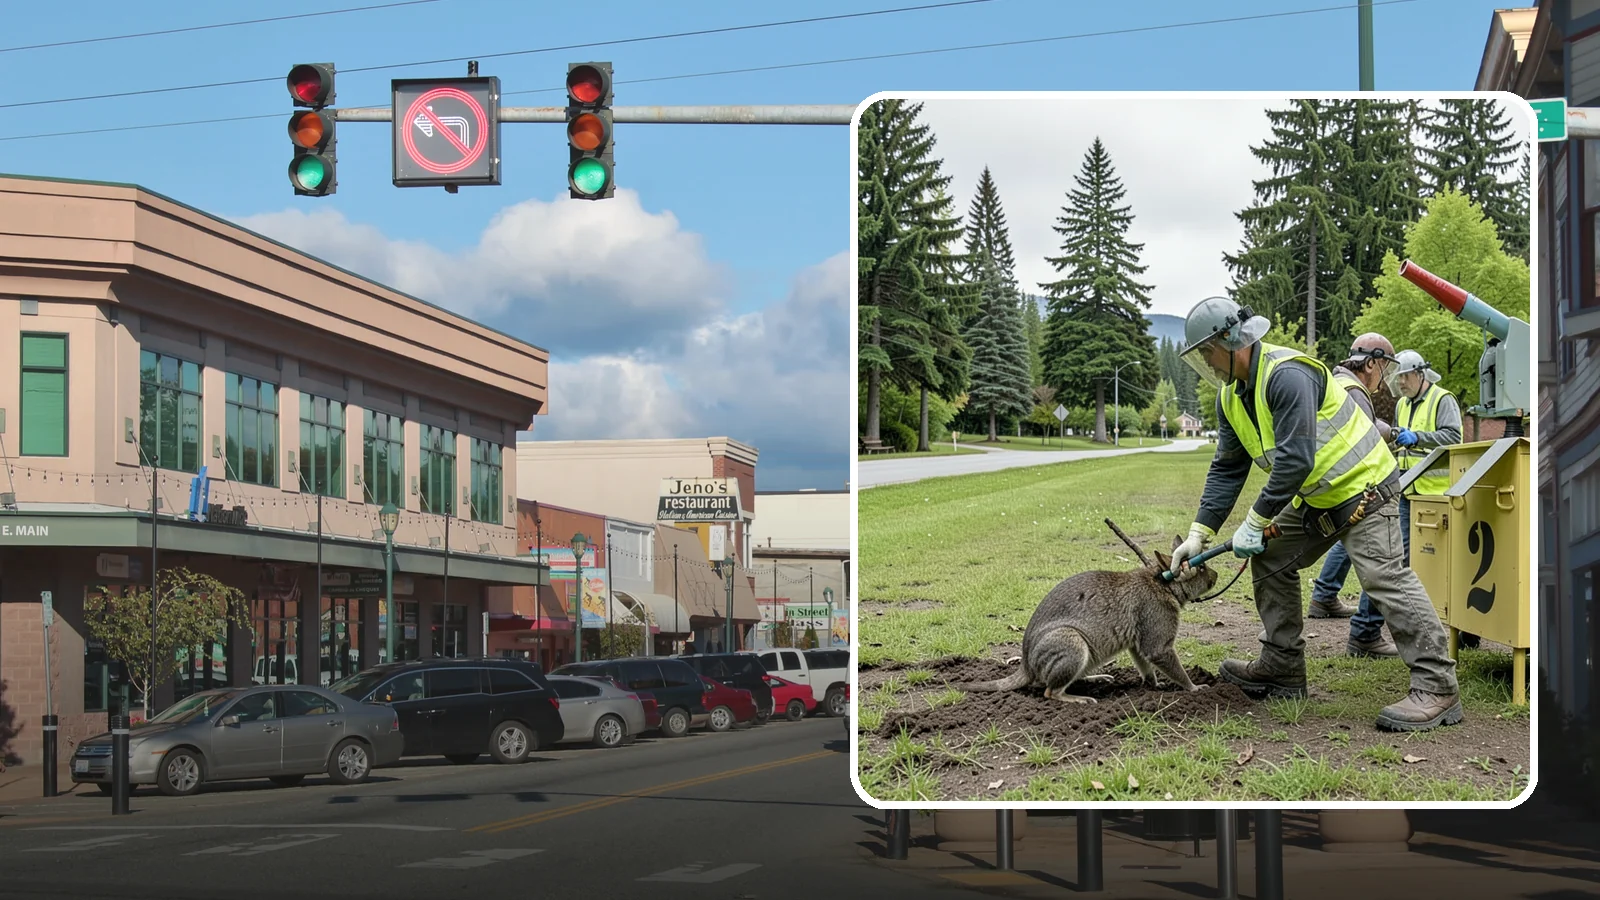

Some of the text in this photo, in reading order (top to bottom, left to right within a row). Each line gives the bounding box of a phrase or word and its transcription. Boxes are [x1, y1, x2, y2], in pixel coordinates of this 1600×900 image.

[669, 479, 727, 495] Jeno's
[665, 496, 731, 509] restaurant
[659, 509, 681, 519] Italian
[686, 509, 714, 519] American
[715, 509, 737, 519] Cuisine
[2, 525, 49, 536] E. MAIN
[1467, 520, 1496, 615] 2
[797, 607, 828, 617] Street
